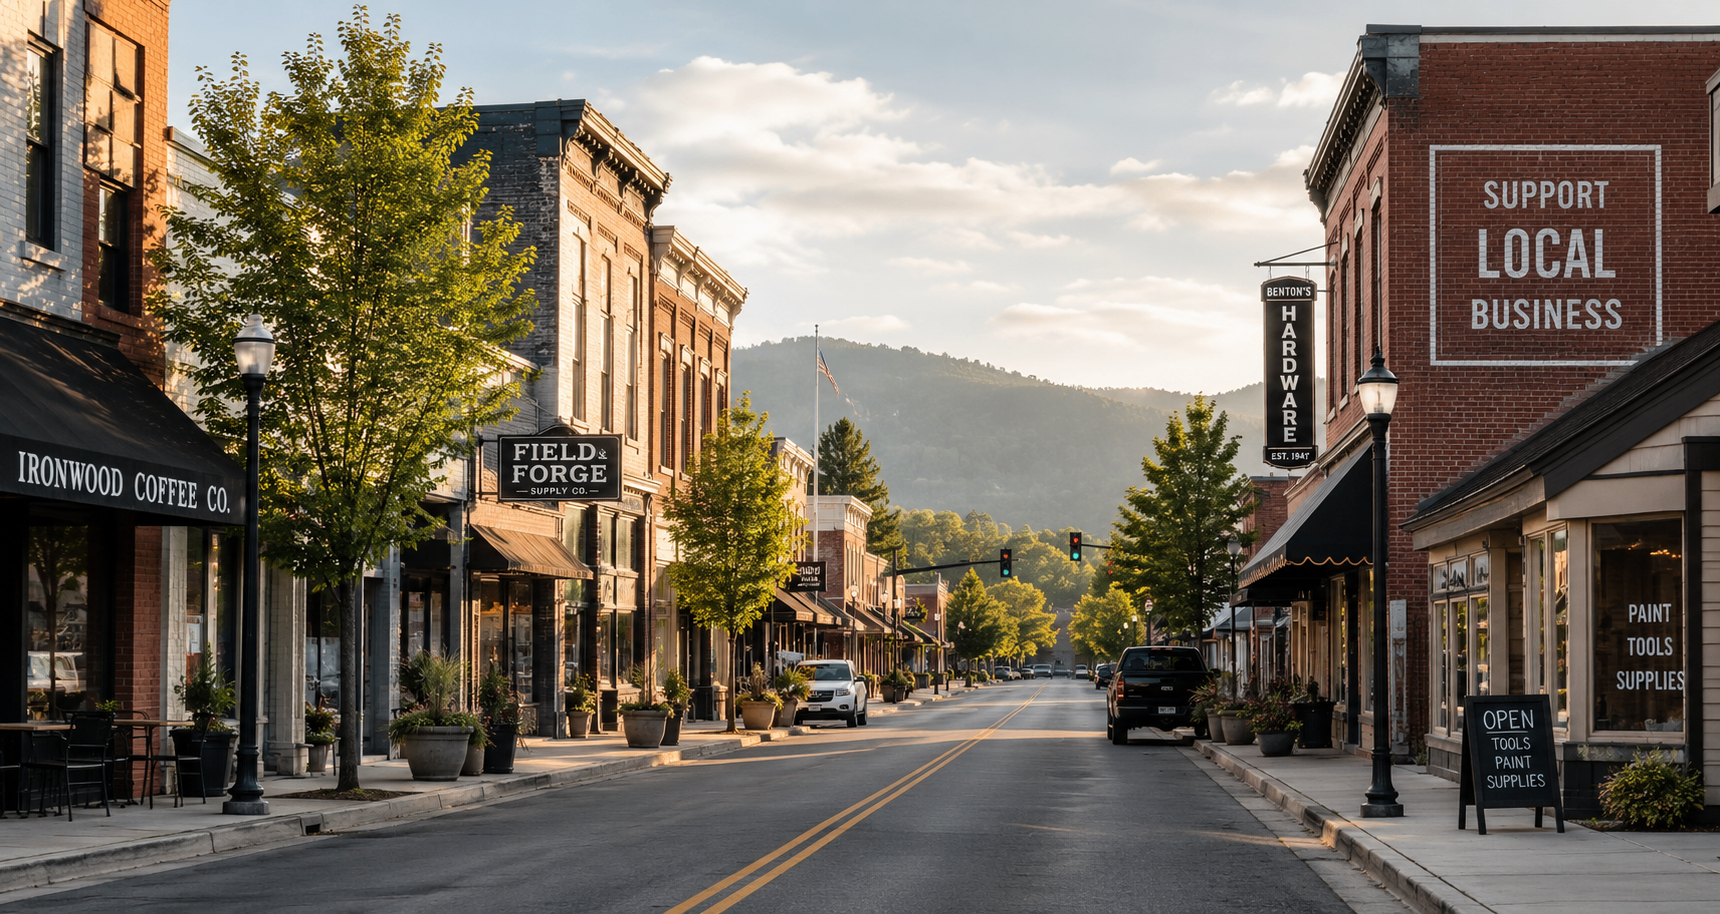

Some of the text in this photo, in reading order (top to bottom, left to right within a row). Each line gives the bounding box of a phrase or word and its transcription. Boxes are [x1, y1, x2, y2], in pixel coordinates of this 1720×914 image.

[1483, 180, 1609, 209] SUPPORT
[1478, 228, 1616, 278] LOCAL
[1267, 286, 1311, 297] BENTON'S
[1471, 299, 1623, 329] BUSINESS
[1280, 305, 1299, 443] HARDWARE
[513, 443, 608, 461] FIELD &
[1271, 452, 1289, 460] EST.
[18, 451, 231, 514] IRONWOOD COFFEE CO.
[512, 464, 607, 483] FORGE
[530, 487, 588, 495] SUPPLY CO.
[1628, 603, 1672, 623] PAINT
[1627, 637, 1673, 656] TOOLS
[1616, 671, 1685, 691] SUPPLIES
[1483, 709, 1534, 730] OPEN
[1491, 737, 1531, 751] TOOLS
[1495, 755, 1532, 770] PAINT
[1487, 773, 1546, 789] SUPPLIES
